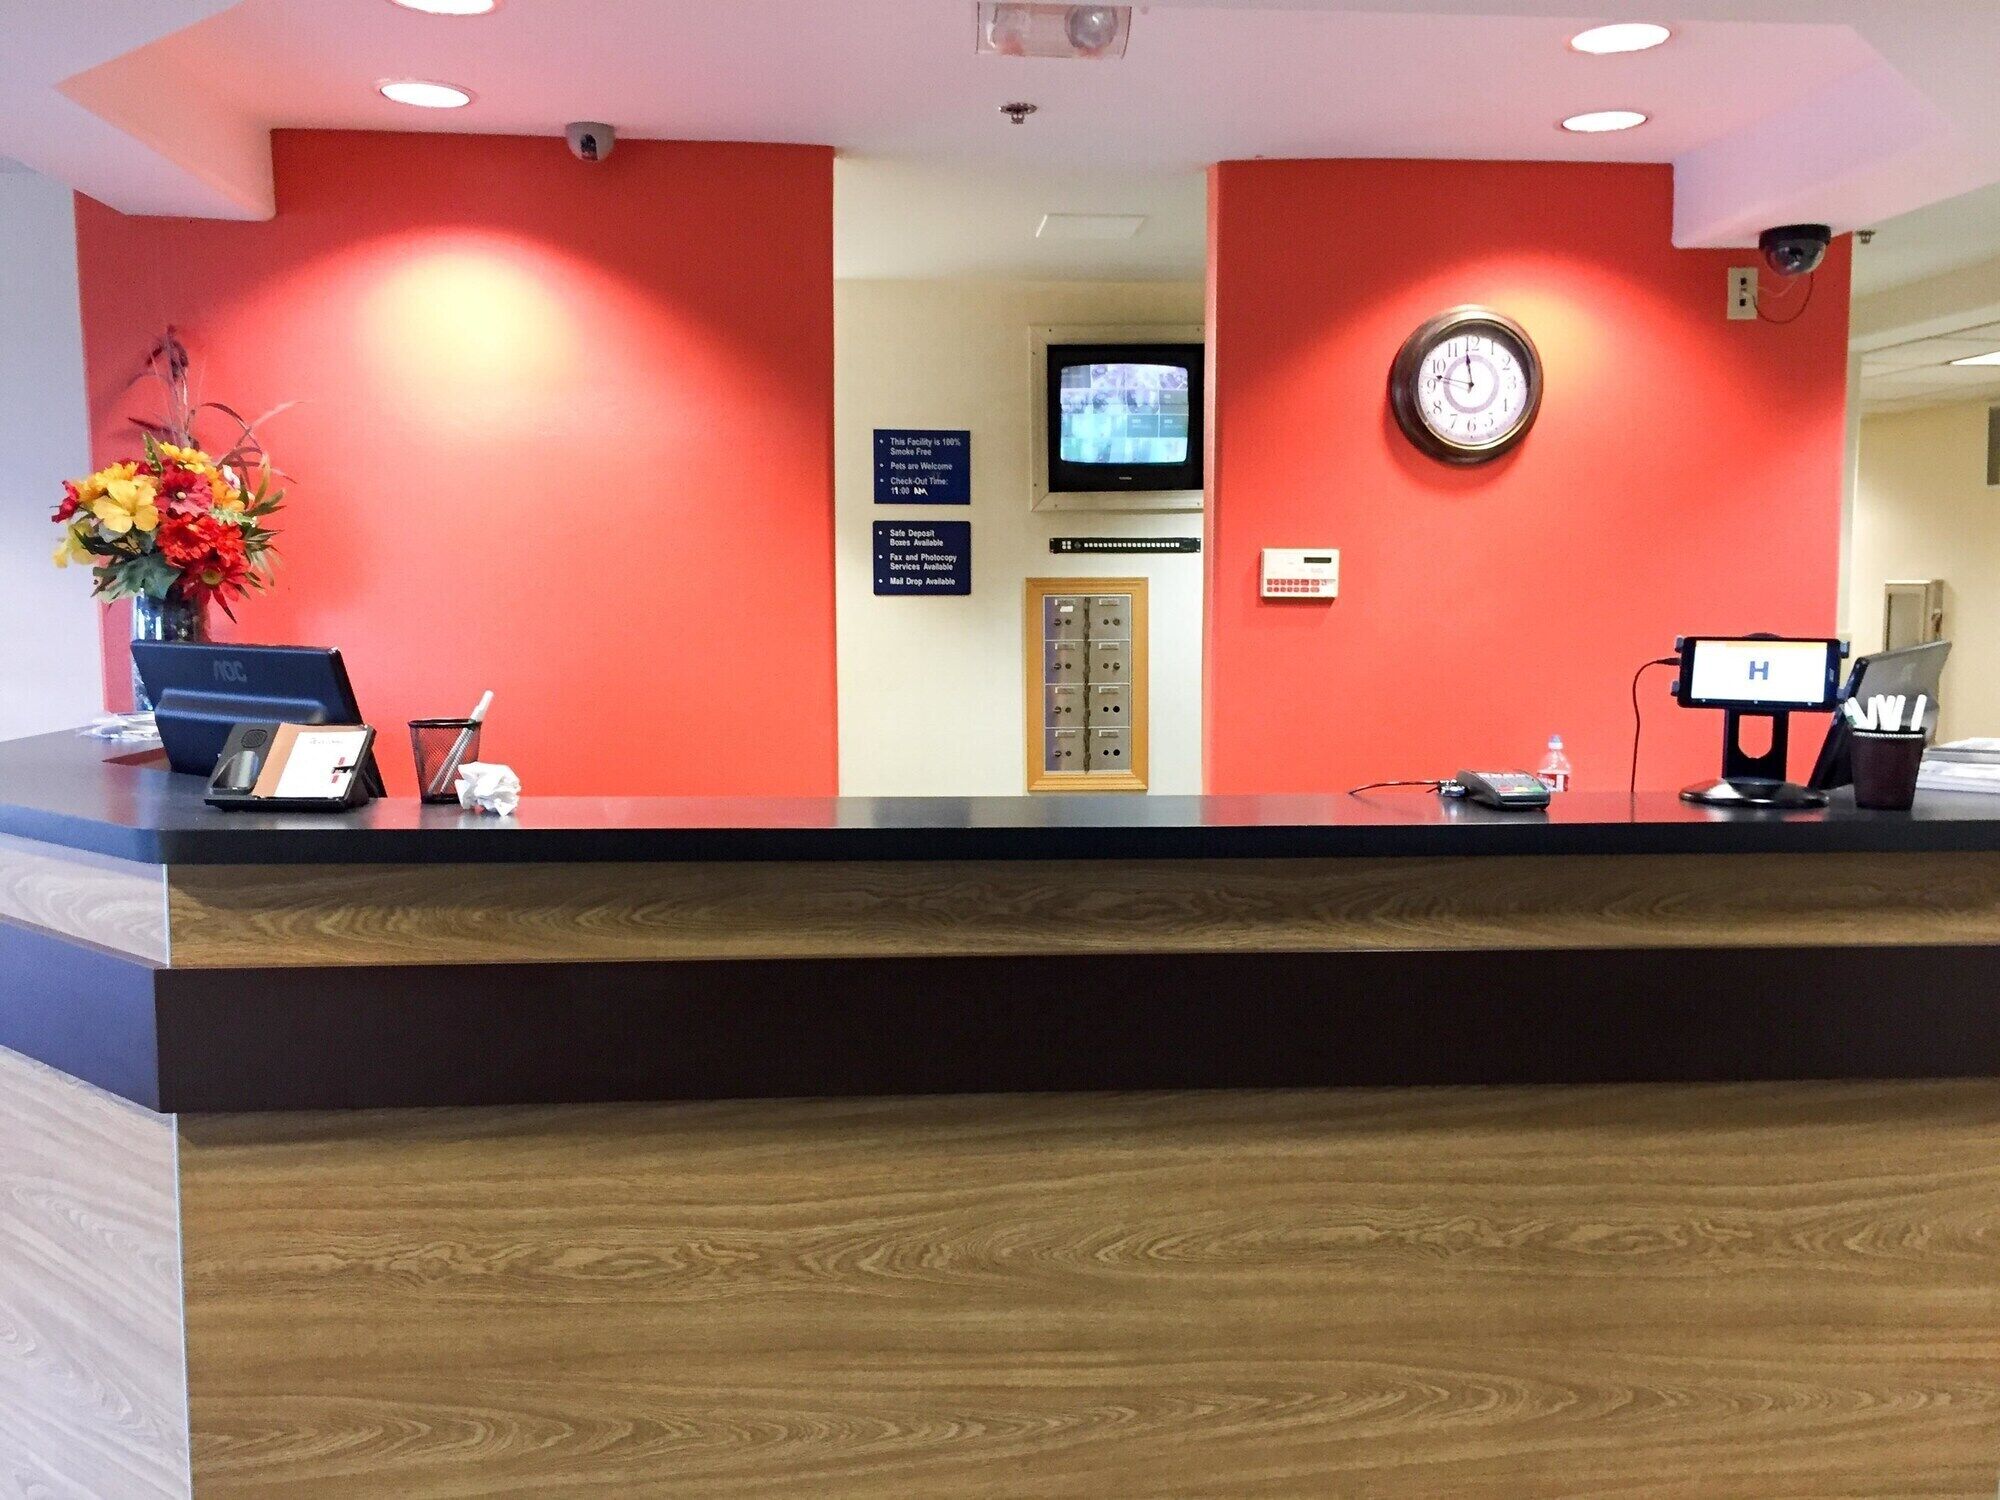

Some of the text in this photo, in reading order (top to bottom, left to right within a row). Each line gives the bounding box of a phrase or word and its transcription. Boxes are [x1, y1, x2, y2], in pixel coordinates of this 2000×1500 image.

[1448, 342, 1458, 357] 11
[1466, 335, 1480, 352] 12
[1432, 358, 1446, 374] 10
[1502, 356, 1511, 371] 2
[1426, 379, 1436, 394] 9
[1433, 400, 1442, 415] 8
[1450, 413, 1458, 430] 7
[1466, 416, 1476, 432] 6
[1484, 412, 1494, 428] 5
[890, 437, 962, 448] This Facility is 100%
[890, 447, 932, 456] Smoke Free
[890, 461, 953, 471] Pets are Welcome
[890, 476, 949, 485] Check-Out Time:
[891, 486, 910, 495] 11:00
[889, 528, 935, 539] Safe Deposit
[889, 538, 944, 547] Boxes Available
[889, 552, 957, 563] Fax and Photocopy
[889, 562, 954, 571] Services Available
[889, 577, 956, 587] Mail Drop Available
[1749, 660, 1770, 681] H
